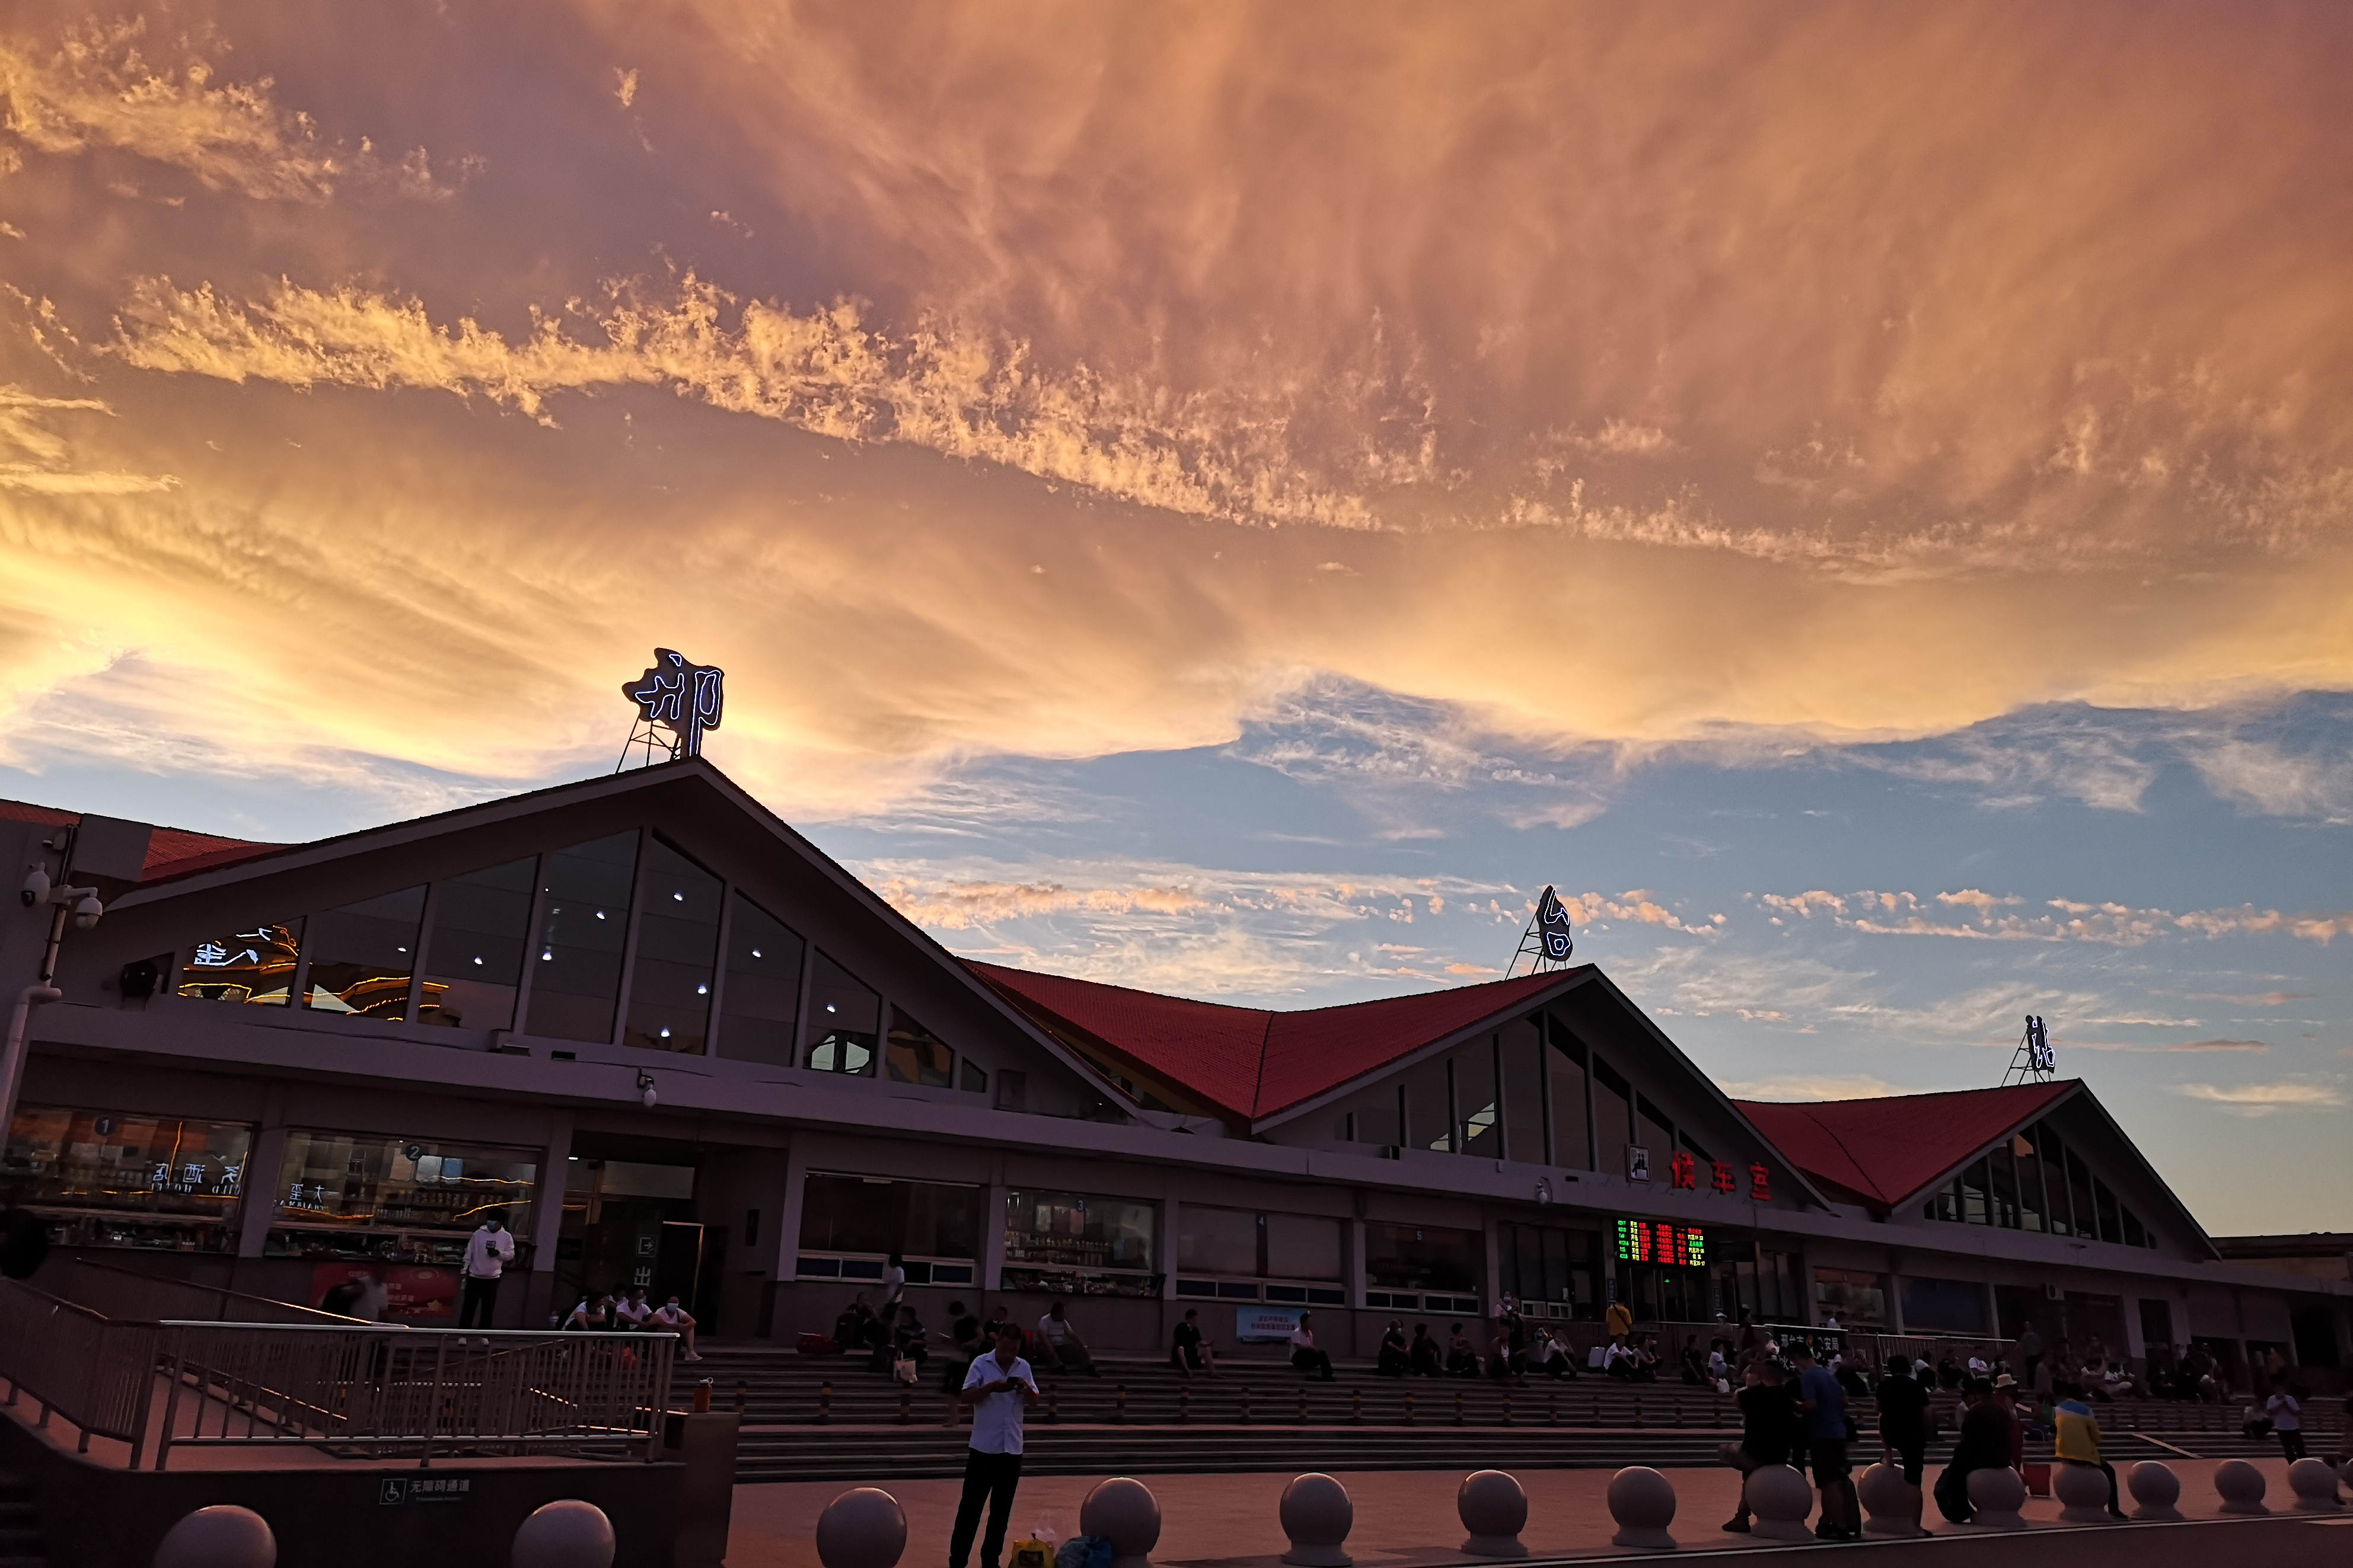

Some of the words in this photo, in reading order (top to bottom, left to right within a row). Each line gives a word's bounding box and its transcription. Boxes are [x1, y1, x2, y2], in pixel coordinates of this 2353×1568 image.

[410, 1146, 420, 1160] 2
[1669, 1152, 1771, 1200] 候车室
[1078, 1200, 1084, 1211] 3
[1258, 1216, 1265, 1226] 4
[1416, 1231, 1423, 1241] 5
